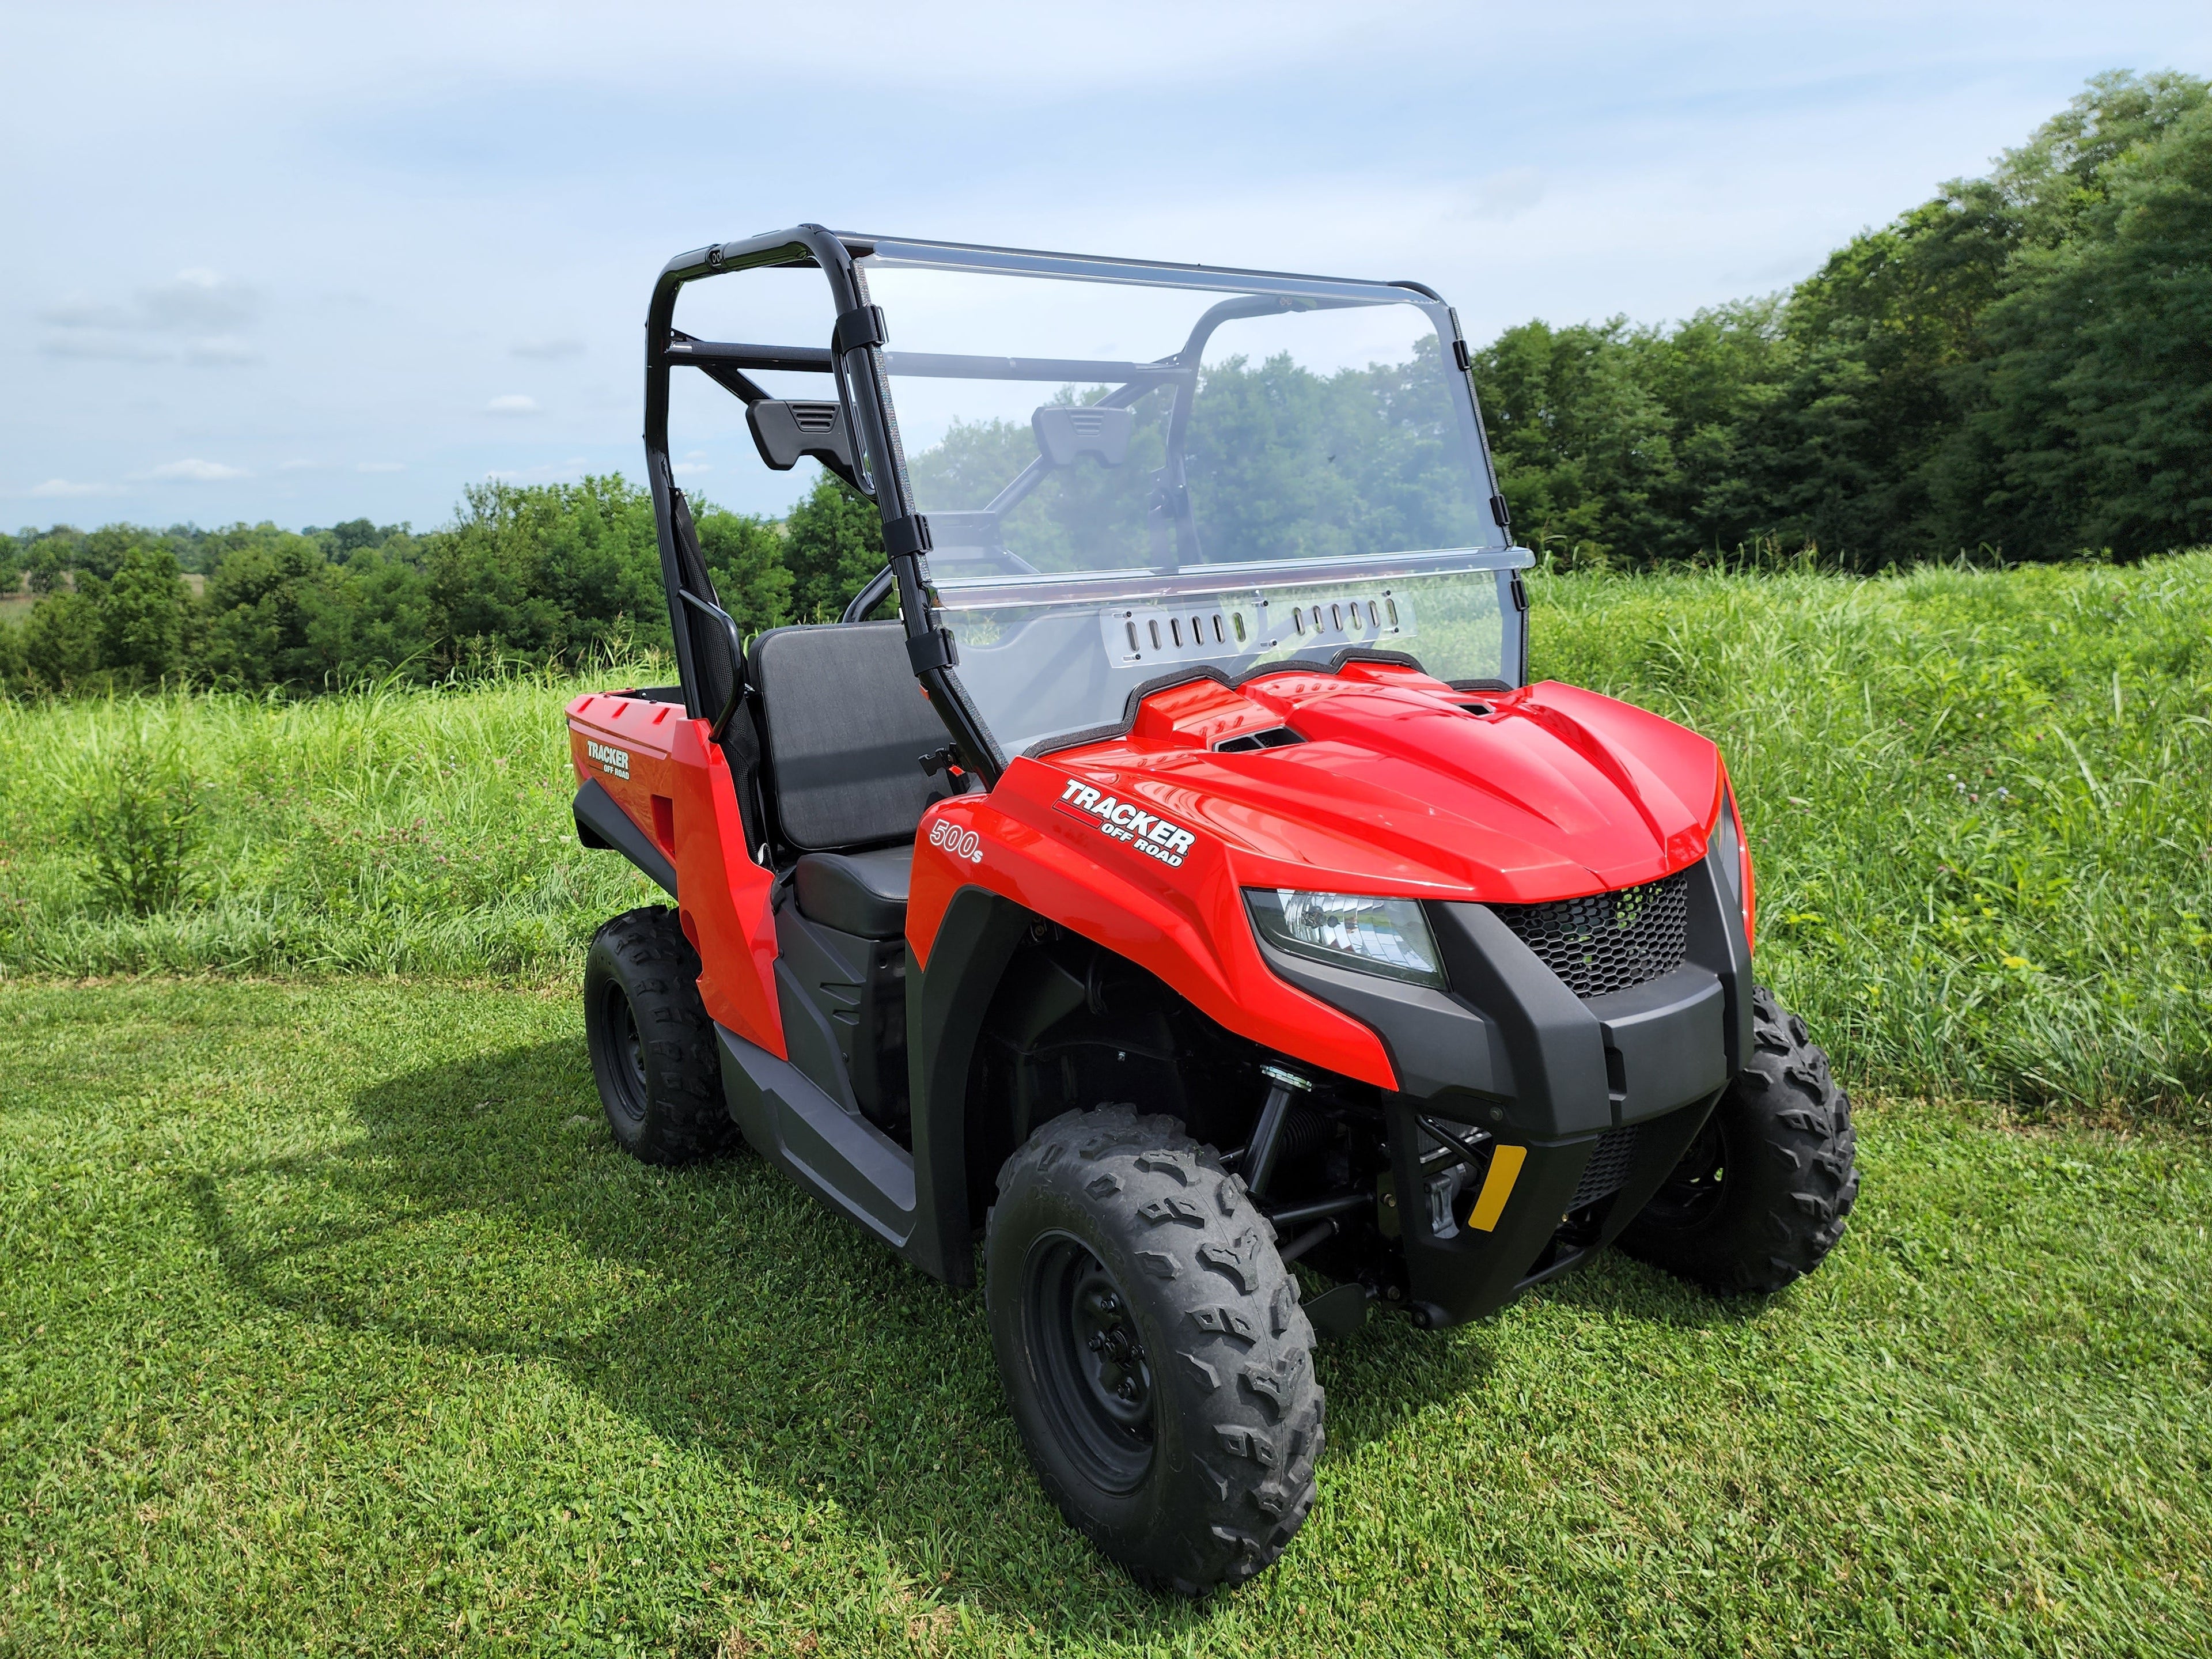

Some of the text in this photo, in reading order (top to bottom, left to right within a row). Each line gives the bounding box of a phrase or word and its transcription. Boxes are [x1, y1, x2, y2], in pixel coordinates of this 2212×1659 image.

[588, 740, 629, 770] TRACKER
[604, 764, 630, 780] OFF ROAD
[1061, 778, 1195, 855] TRACKER
[1101, 823, 1183, 867] OFF ROAD
